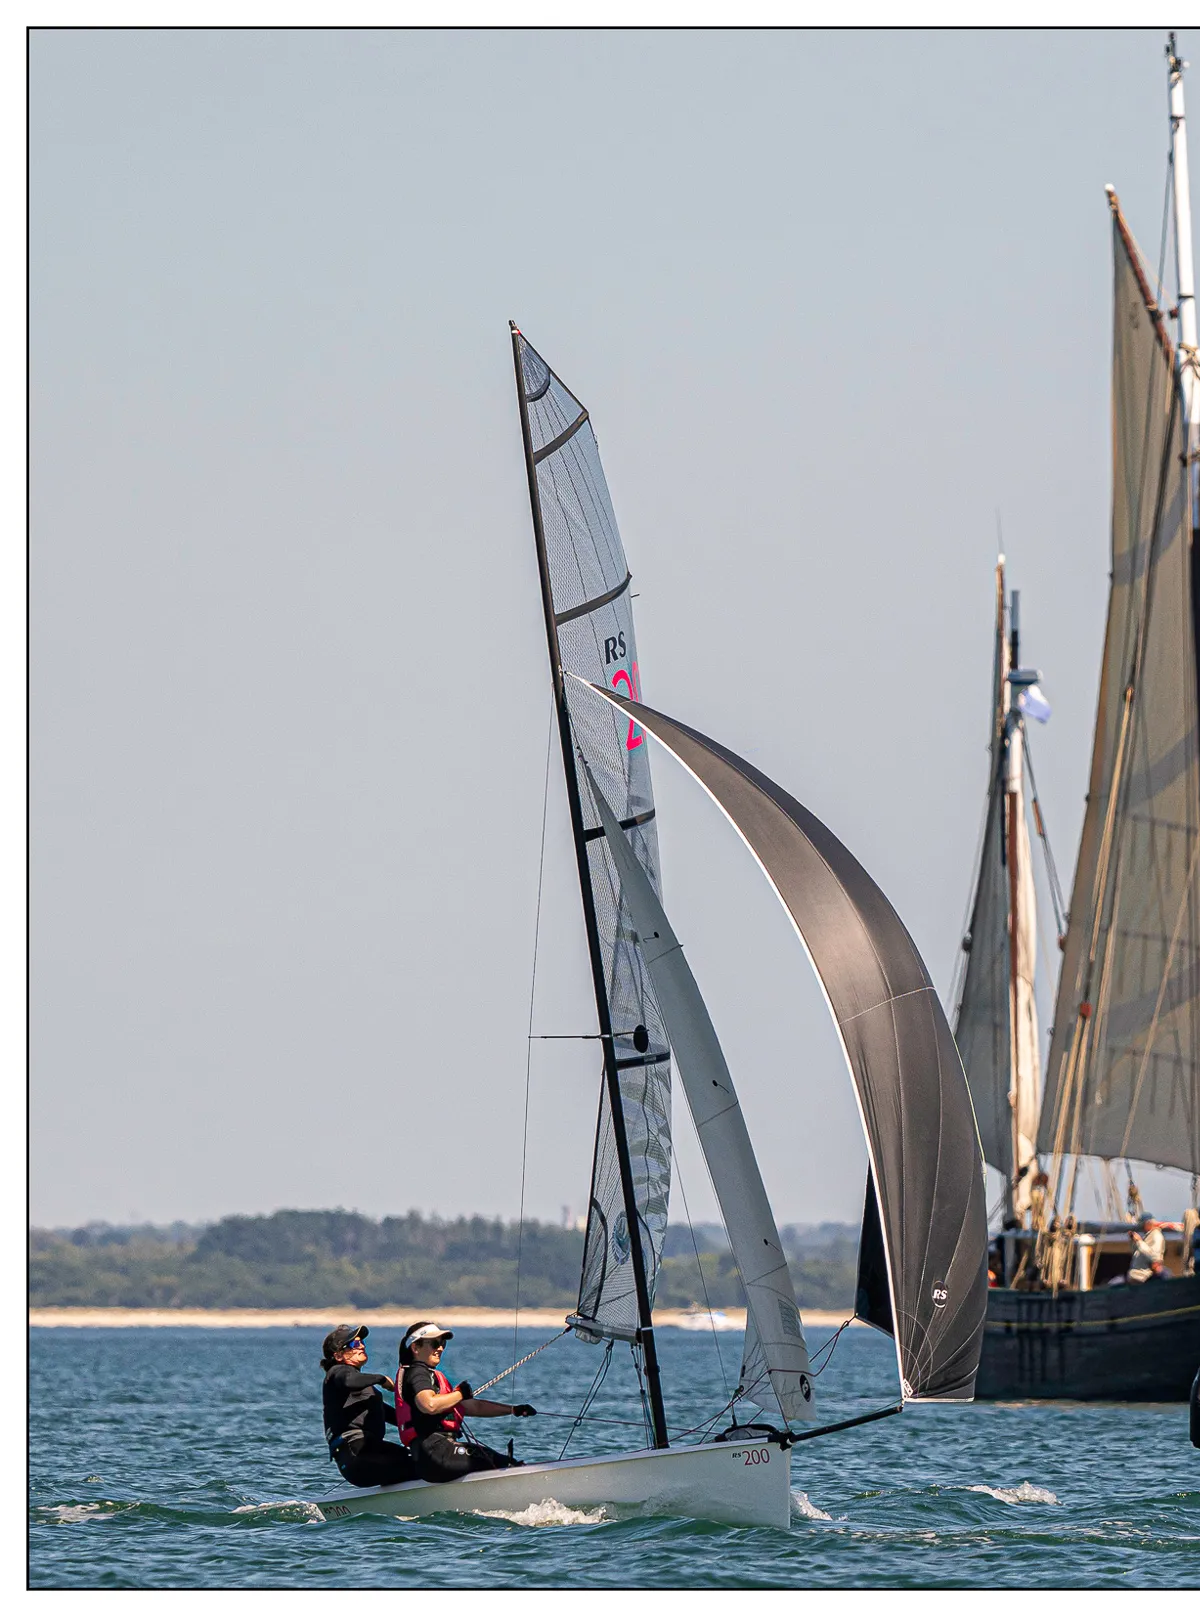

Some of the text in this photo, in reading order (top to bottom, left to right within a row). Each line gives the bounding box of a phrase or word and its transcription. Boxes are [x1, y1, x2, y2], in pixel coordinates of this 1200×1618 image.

[604, 631, 626, 664] RS
[932, 1289, 948, 1300] RS
[742, 1448, 770, 1466] 200
